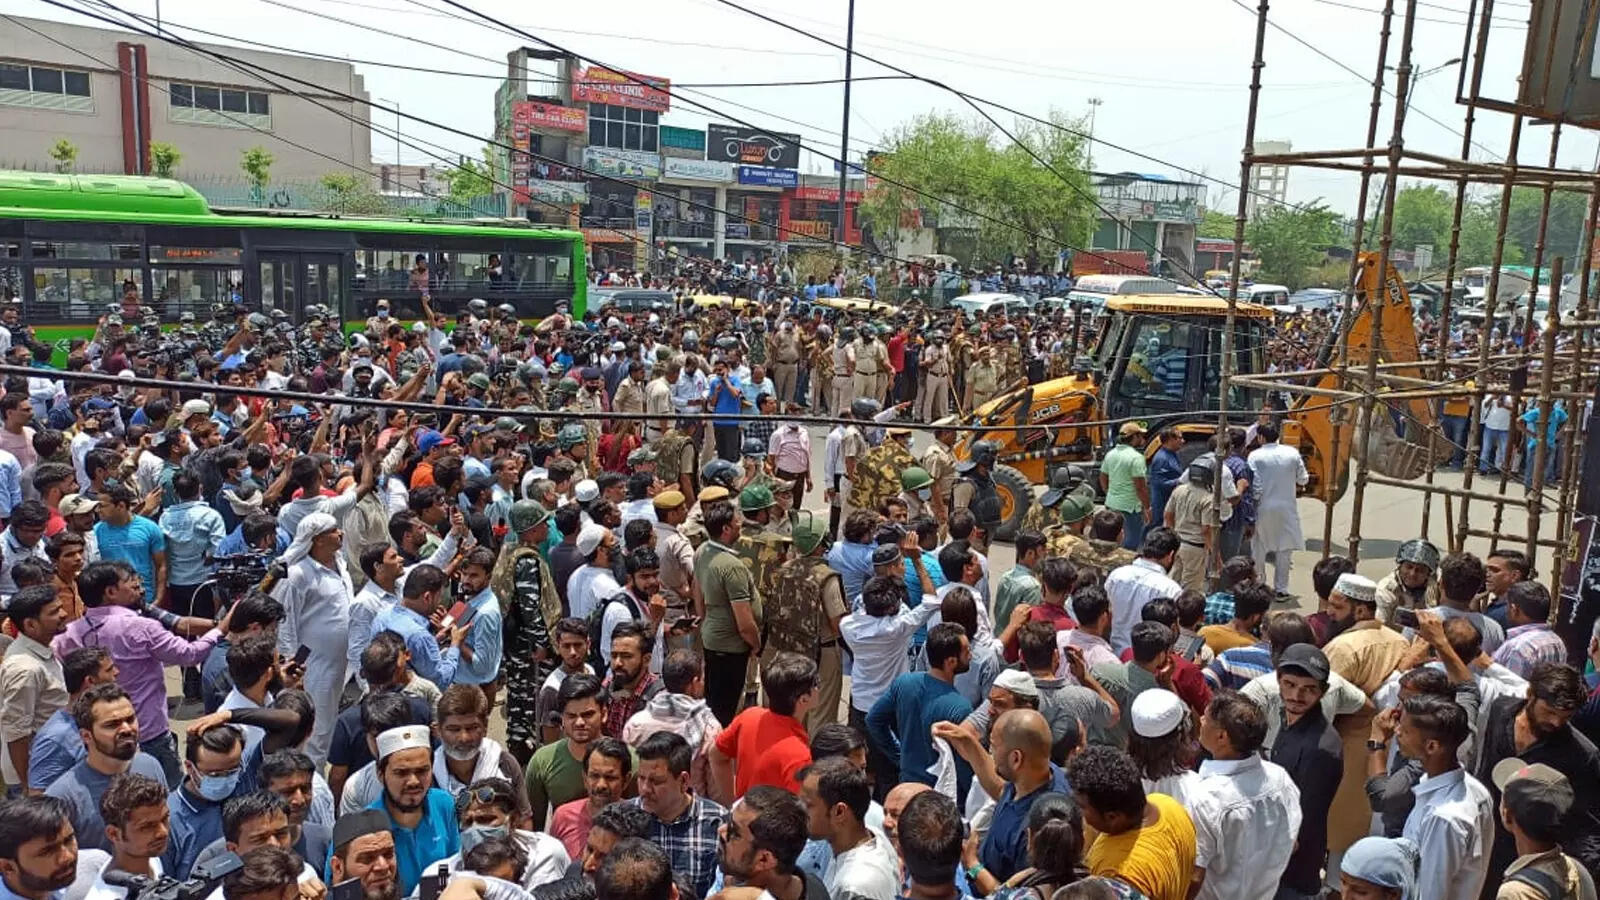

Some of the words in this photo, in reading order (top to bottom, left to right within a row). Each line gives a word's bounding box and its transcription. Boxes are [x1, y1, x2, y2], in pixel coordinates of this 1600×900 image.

[614, 82, 645, 97] CLINIC
[531, 111, 544, 119] THE
[1031, 404, 1060, 420] JCB
